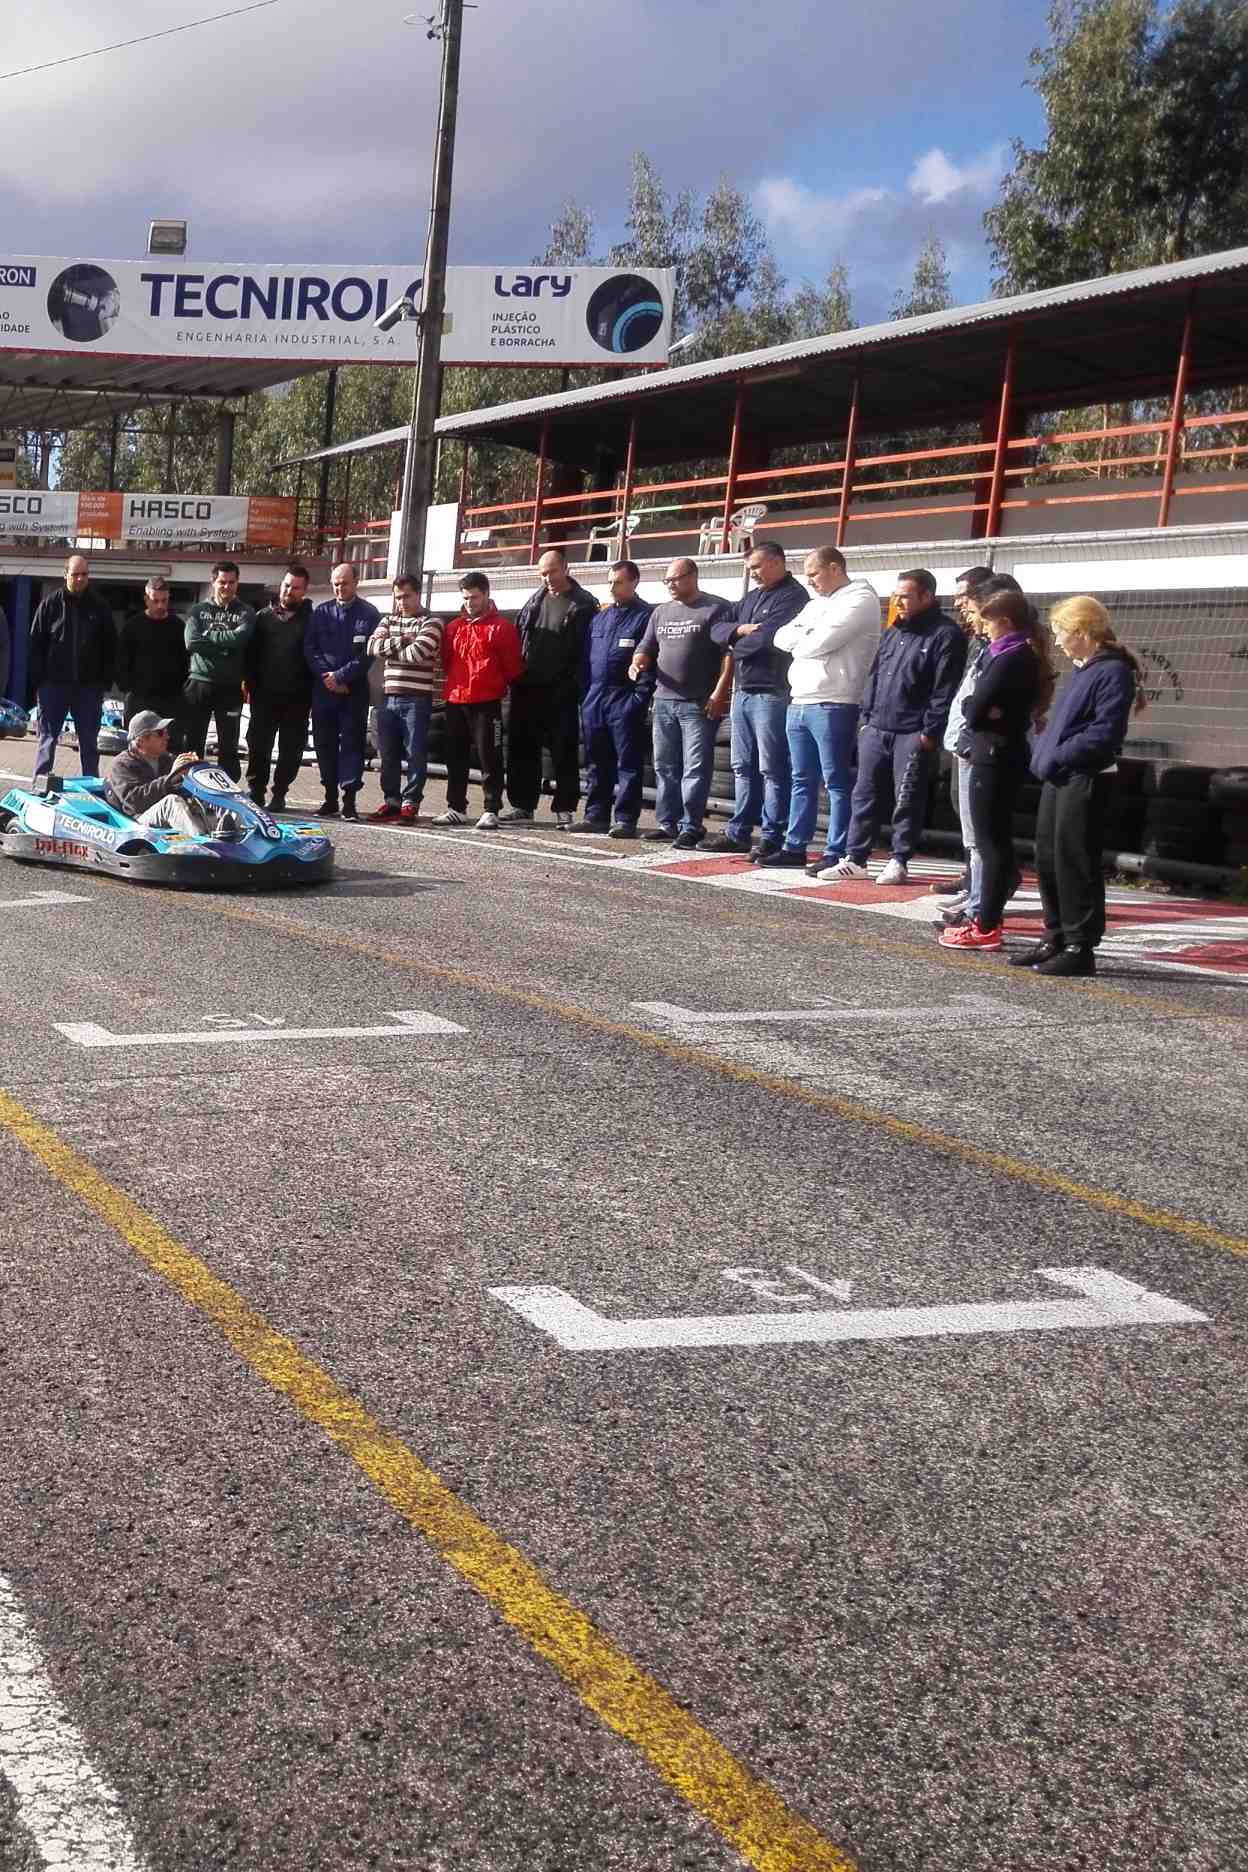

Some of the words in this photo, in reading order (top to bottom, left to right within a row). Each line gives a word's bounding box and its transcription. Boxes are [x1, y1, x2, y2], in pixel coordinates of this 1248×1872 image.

[492, 311, 537, 324] INJEÇÃO
[491, 323, 541, 334] PLÁSTICO
[176, 331, 268, 344] ENGENHARIA
[275, 334, 367, 346] INDUSTRIAL,
[490, 338, 497, 346] E
[499, 338, 556, 347] BORRACHA
[130, 500, 212, 520] HASCO
[209, 771, 230, 789] 19
[56, 814, 115, 845] TECNIROLO
